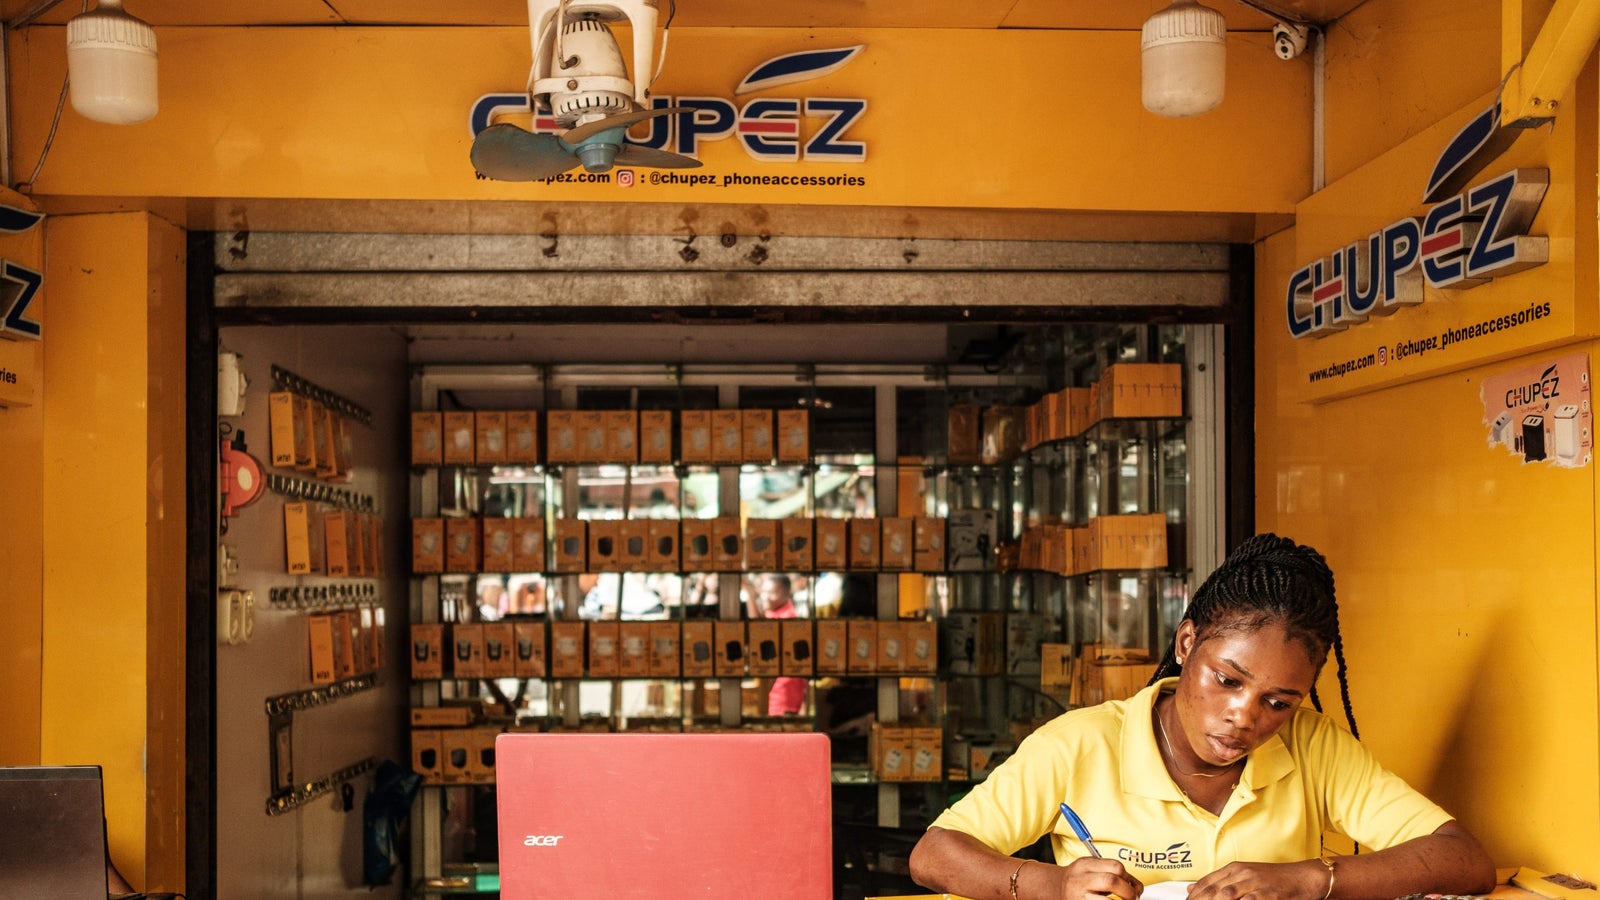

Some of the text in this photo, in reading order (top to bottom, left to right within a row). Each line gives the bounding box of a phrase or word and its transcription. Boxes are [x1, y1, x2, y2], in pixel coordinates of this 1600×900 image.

[468, 92, 867, 163] CUPEZ
[649, 170, 866, 187] @chupez_phoneaccessories
[1286, 168, 1522, 338] CHUPEZ
[1309, 352, 1376, 383] www.chupez.com
[1396, 301, 1551, 360] @chupez_phoneaccessories
[1505, 376, 1560, 409] CHUPEZ
[523, 835, 564, 847] acer
[1118, 847, 1192, 864] CHUPEZ
[1156, 862, 1193, 870] ACCESSORIES
